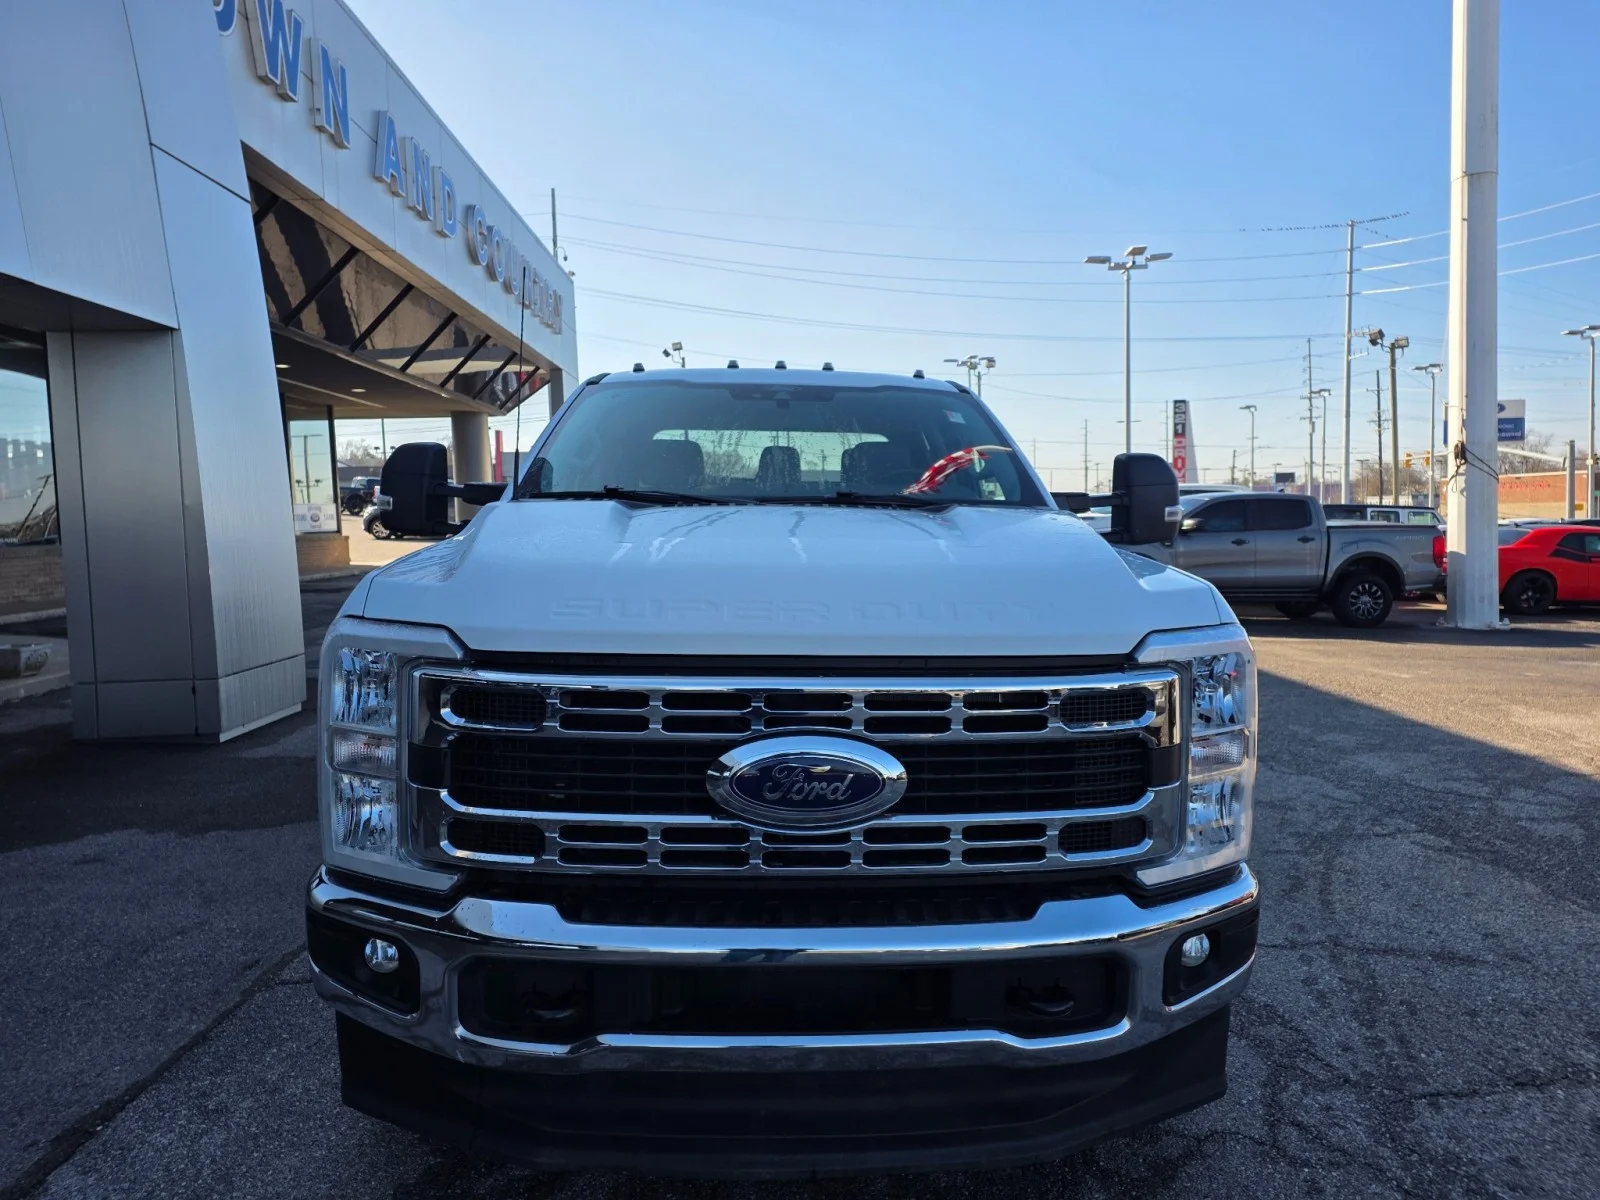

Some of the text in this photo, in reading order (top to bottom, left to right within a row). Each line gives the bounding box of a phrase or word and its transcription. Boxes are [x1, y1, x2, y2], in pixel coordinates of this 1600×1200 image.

[375, 110, 457, 238] AND
[1174, 402, 1186, 434] 321
[549, 598, 1055, 624] SUPER DUTY
[763, 763, 854, 801] Ford
